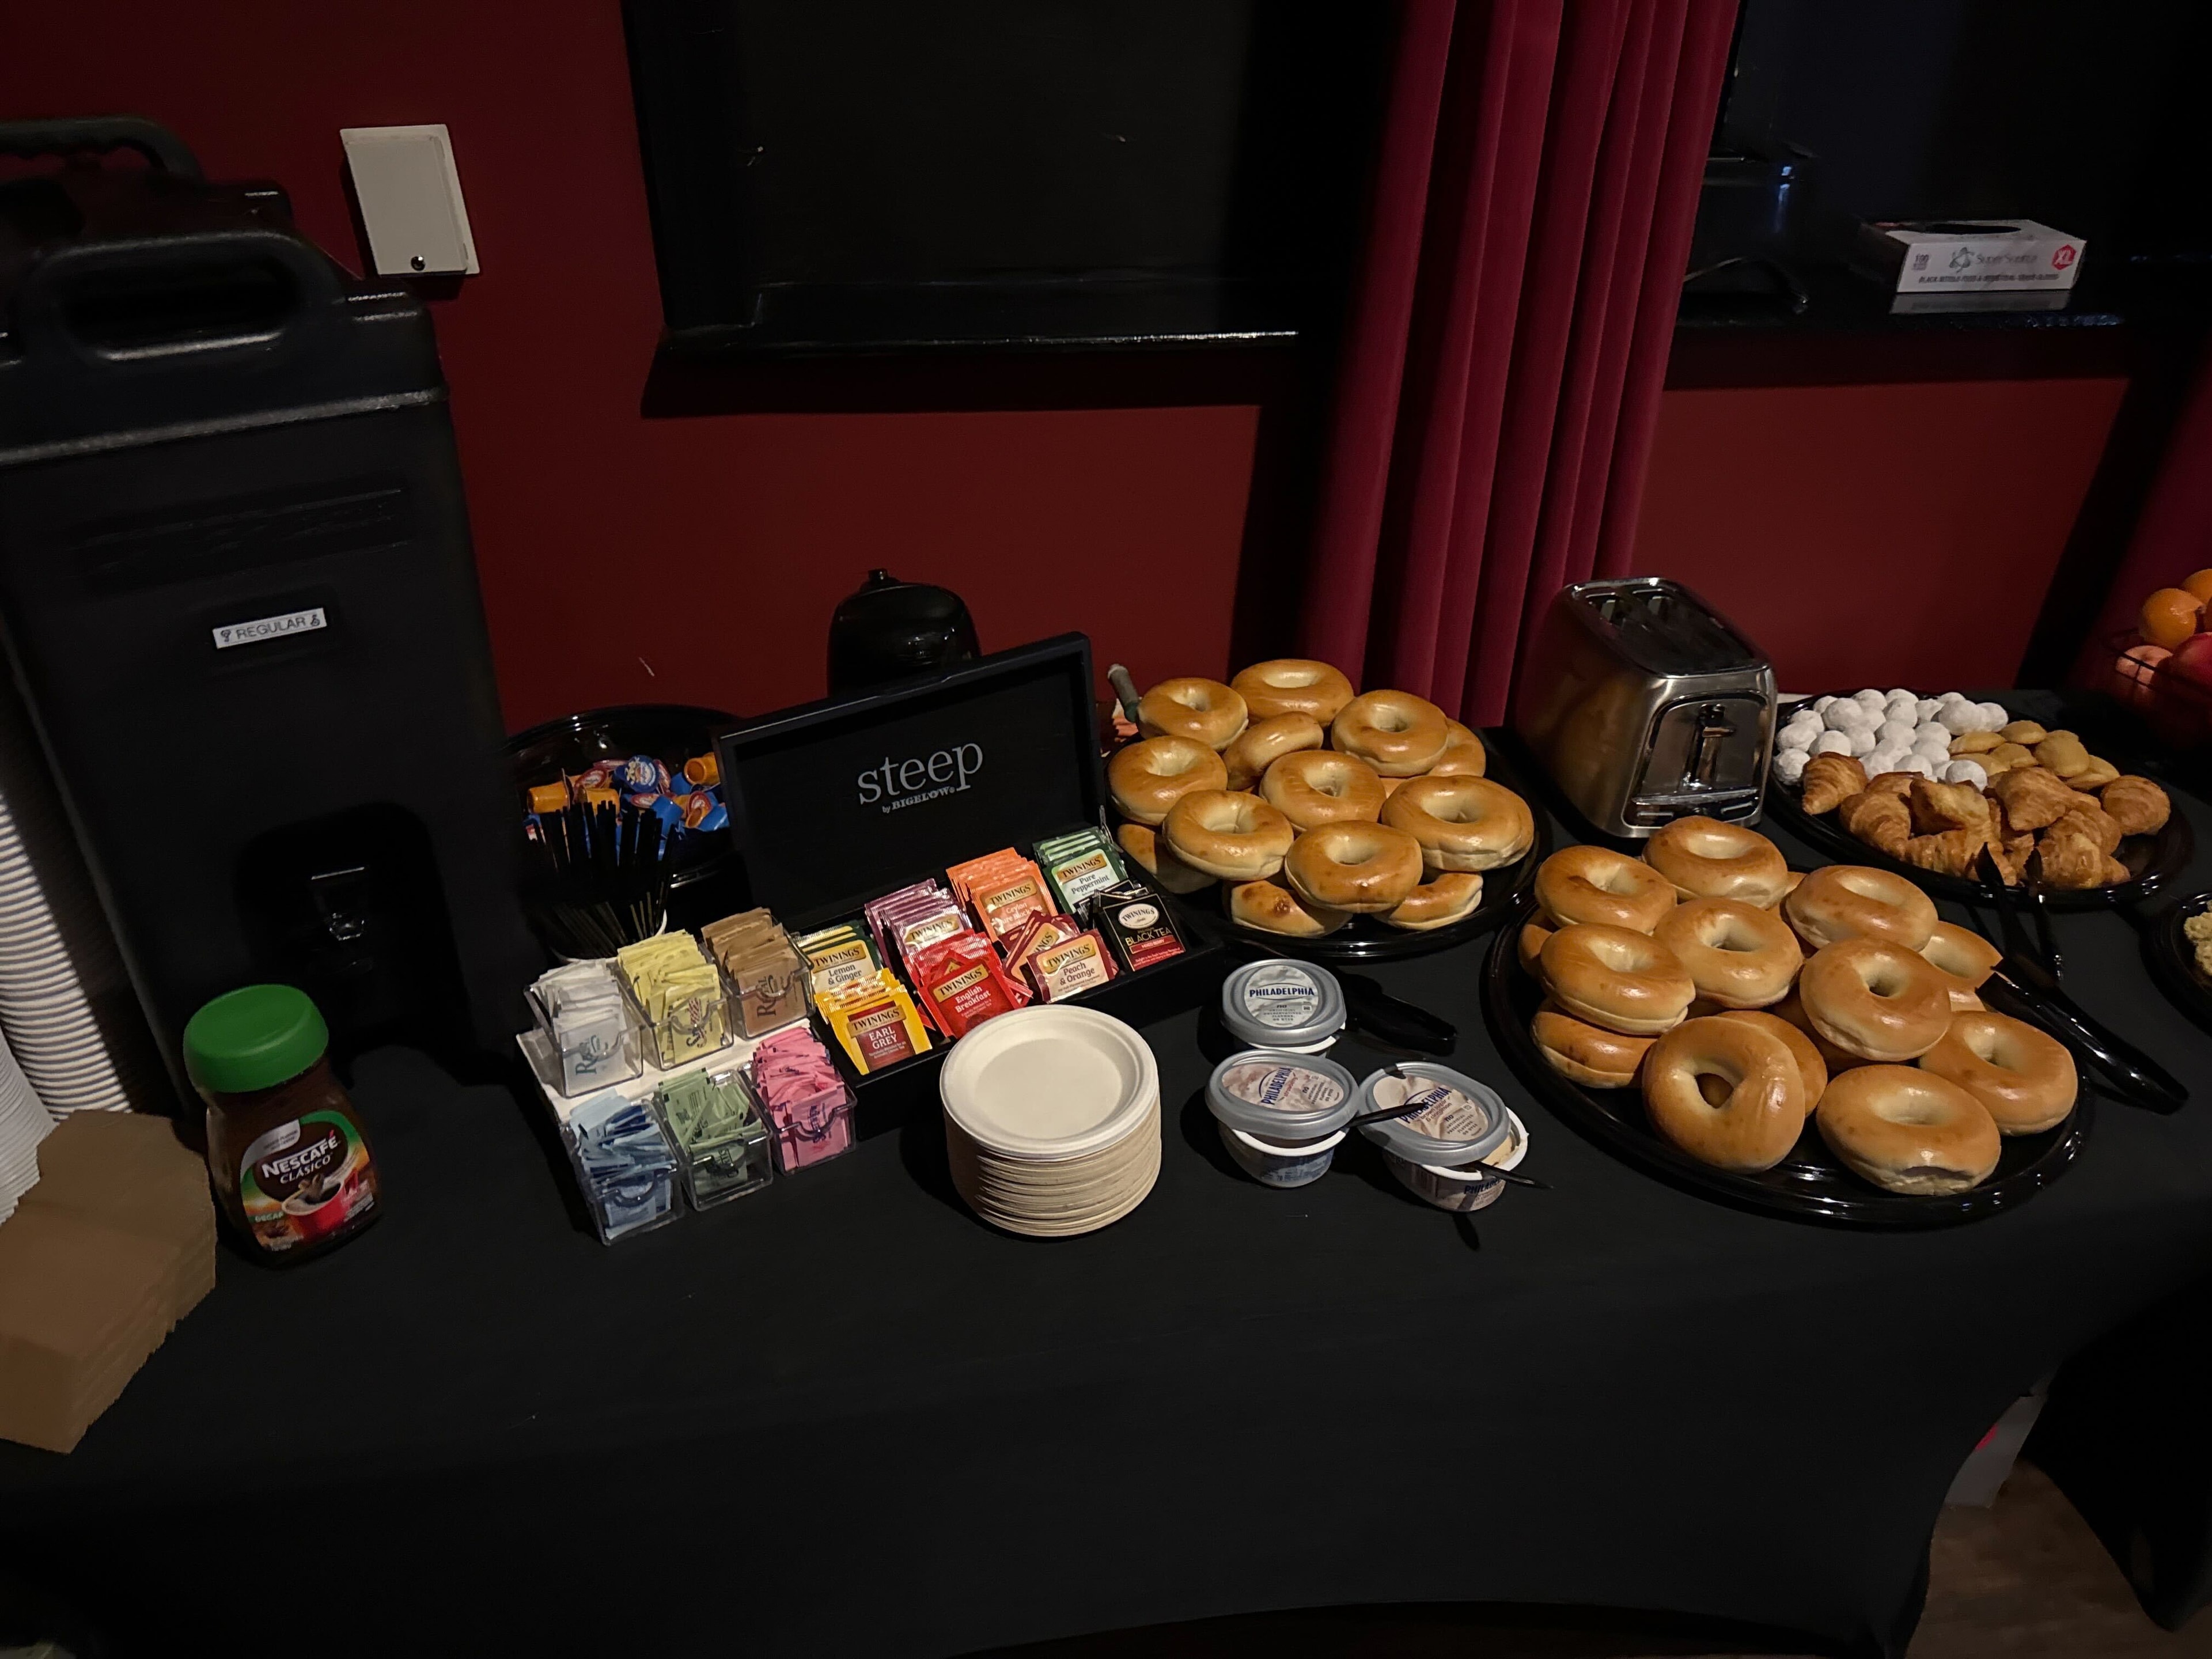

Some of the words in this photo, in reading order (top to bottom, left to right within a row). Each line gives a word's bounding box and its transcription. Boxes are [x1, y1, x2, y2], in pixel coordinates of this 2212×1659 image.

[2053, 250, 2074, 266] XL
[236, 616, 306, 639] REGULAR
[857, 743, 983, 805] steep
[882, 805, 891, 814] by
[1061, 857, 1101, 878] TWININGS
[1070, 875, 1110, 895] Peppermint
[1078, 874, 1096, 885] Pure
[990, 885, 1032, 905] TWININGS
[1006, 902, 1028, 915] Ceylon
[1121, 907, 1155, 922] TWININGS
[910, 919, 953, 940] TWININGS
[1124, 931, 1155, 946] BLACK
[1153, 926, 1172, 937] TEA
[813, 948, 860, 968] TWININGS
[1047, 945, 1090, 968] TWININGS
[828, 964, 856, 977] Lemon
[828, 978, 835, 986] &
[835, 969, 862, 984] Ginger
[1059, 978, 1066, 986] &
[1066, 968, 1095, 983] Orange
[1063, 961, 1086, 976] Peach
[938, 968, 982, 996] TWININGS
[955, 986, 983, 1004] English
[1249, 987, 1315, 997] PHILADELPHIA
[955, 990, 991, 1013] Breakfast
[851, 1008, 900, 1032] TWININGS
[869, 1026, 896, 1041] EARL
[872, 1034, 897, 1050] GREY
[1261, 1067, 1294, 1105] PHILADELPHIA
[1421, 1108, 1435, 1120] brown
[1431, 1103, 1452, 1119] cinnamon
[1444, 1114, 1454, 1122] no
[261, 1129, 339, 1179] NESCAFÉ
[255, 1211, 284, 1222] DECAF
